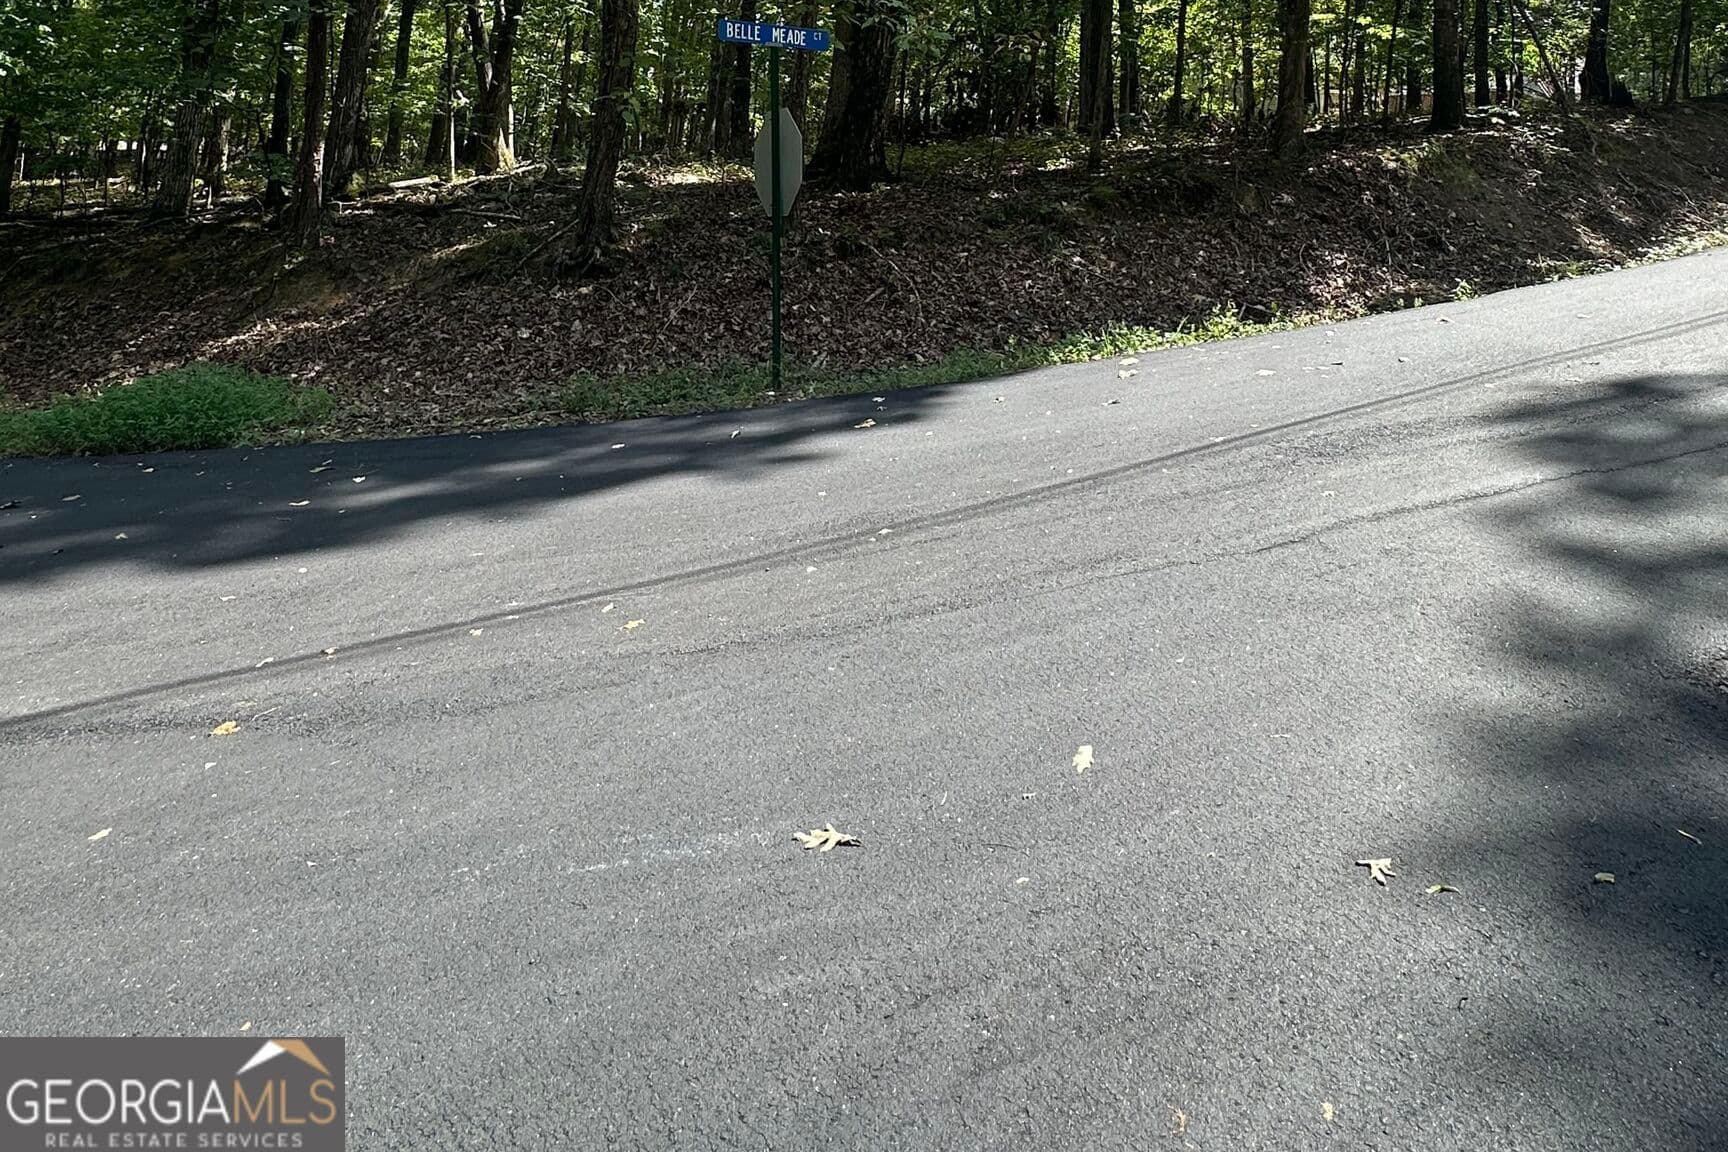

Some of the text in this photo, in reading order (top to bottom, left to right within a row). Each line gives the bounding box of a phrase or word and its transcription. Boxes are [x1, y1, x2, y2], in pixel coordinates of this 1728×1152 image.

[726, 22, 823, 46] BELLE MEADE CT
